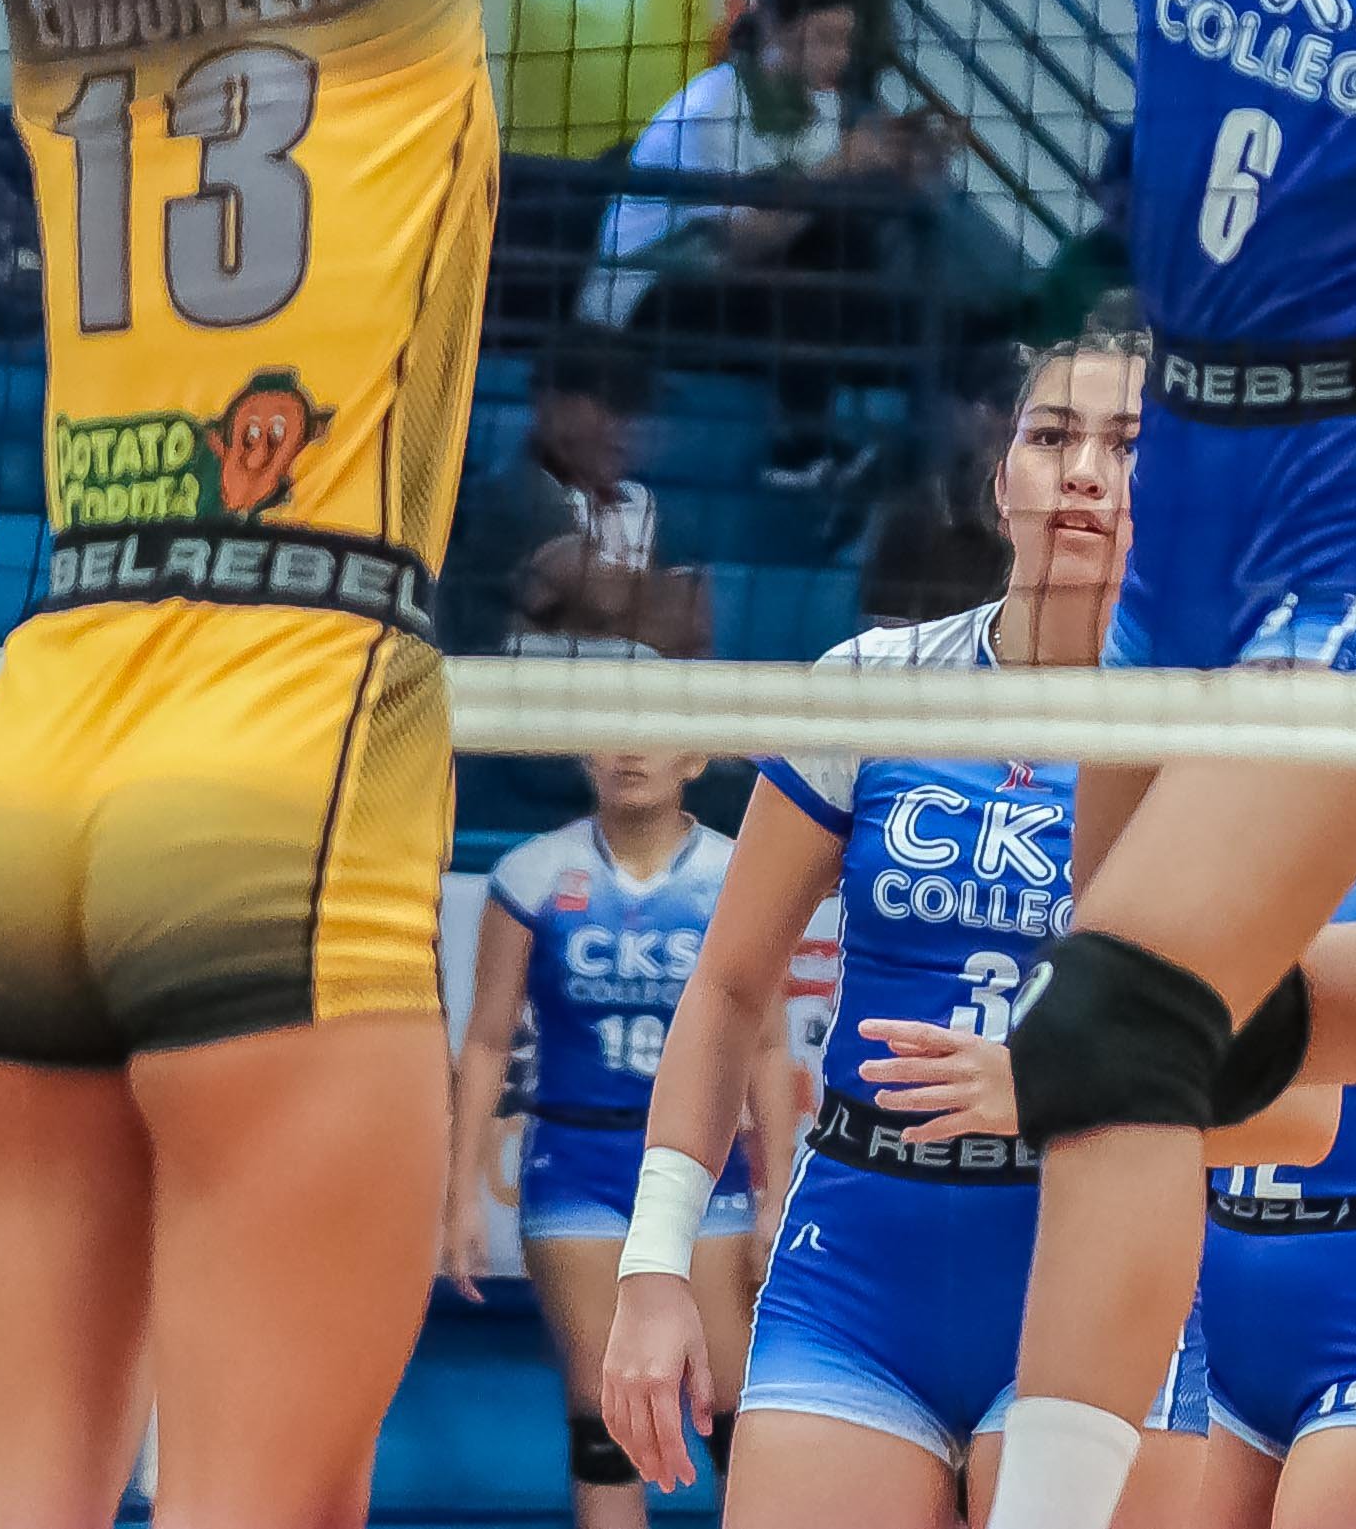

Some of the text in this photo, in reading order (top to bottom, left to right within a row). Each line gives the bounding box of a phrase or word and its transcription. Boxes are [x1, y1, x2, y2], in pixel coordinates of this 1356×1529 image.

[55, 42, 320, 336] 13
[1197, 107, 1282, 265] 6
[883, 784, 1074, 887] CK
[566, 924, 702, 981] CKS
[948, 952, 1021, 1044] 3
